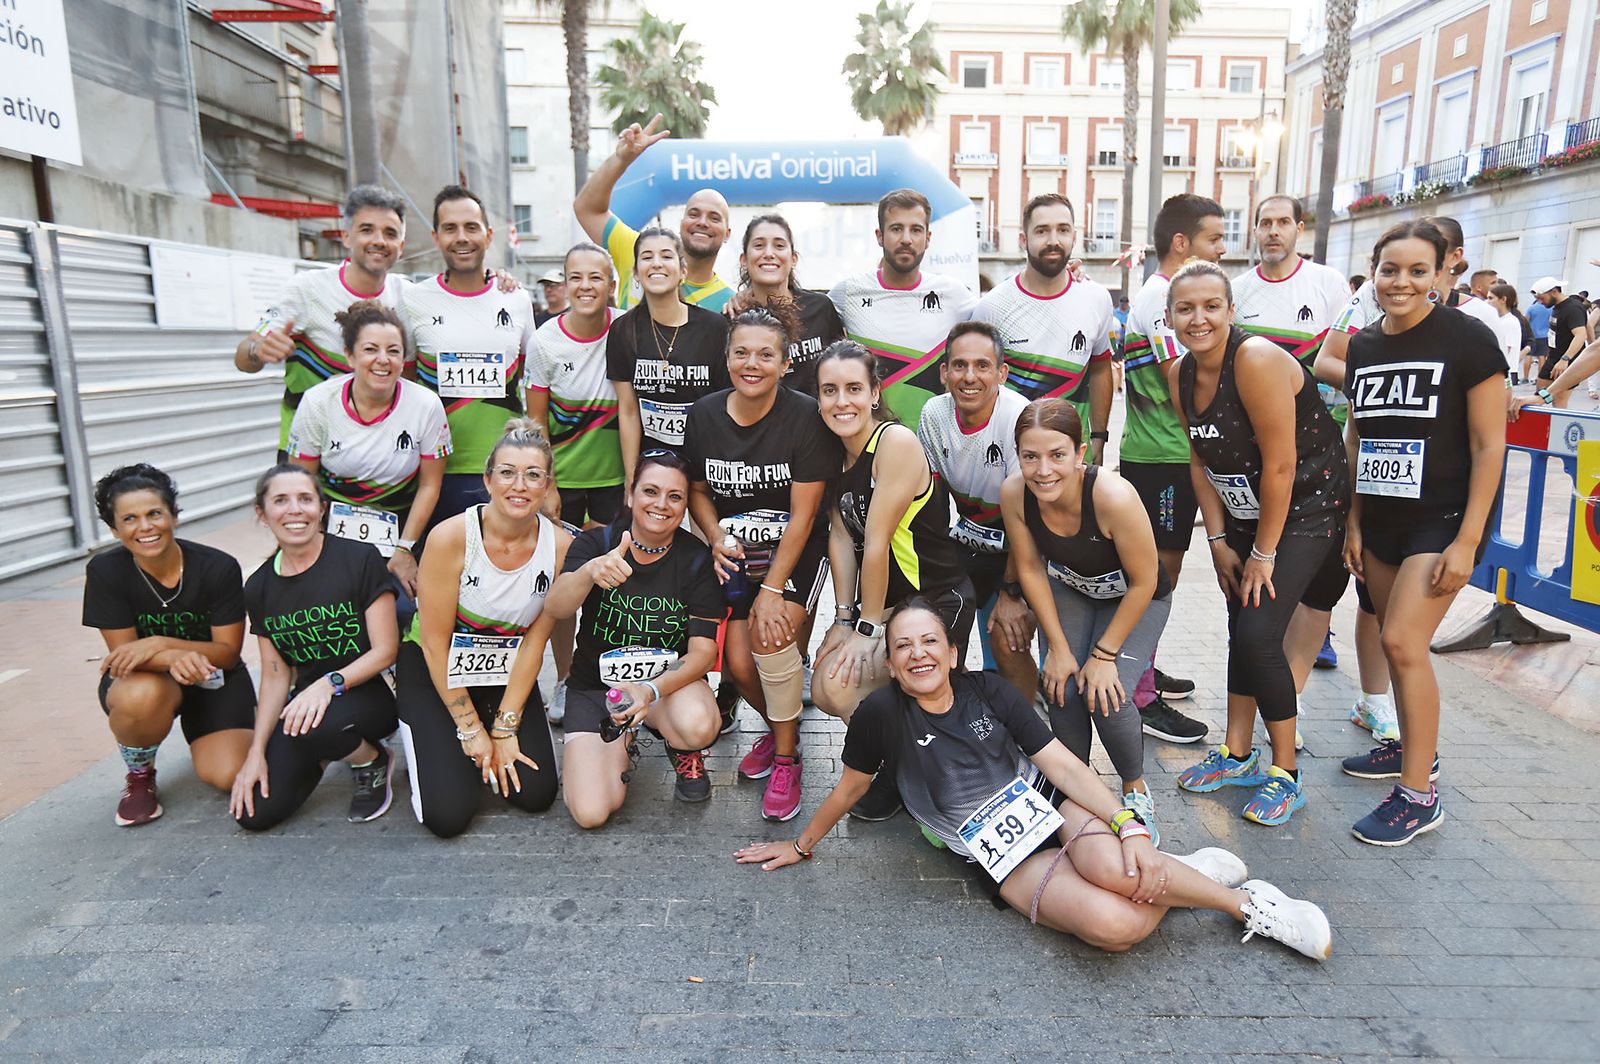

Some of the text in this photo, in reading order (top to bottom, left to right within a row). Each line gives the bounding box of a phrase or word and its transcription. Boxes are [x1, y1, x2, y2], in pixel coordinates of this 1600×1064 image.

[780, 149, 878, 184] original
[801, 336, 822, 355] FUN
[457, 367, 487, 384] 114
[636, 363, 709, 380] RUN FOR FUN
[1356, 374, 1424, 408] IZAL
[656, 417, 685, 433] 743
[1189, 424, 1220, 440] FILA
[708, 462, 792, 483] RUN FOR FUN
[1370, 459, 1401, 480] 809
[359, 523, 369, 540] 9
[739, 526, 771, 542] 106
[264, 601, 358, 631] FUNCIONAL
[597, 602, 688, 634] FITNESS
[272, 618, 360, 649] FITNESS
[464, 653, 497, 671] 326
[621, 662, 656, 680] 257
[980, 793, 1008, 816] NOCTURNA
[994, 814, 1025, 844] 59
